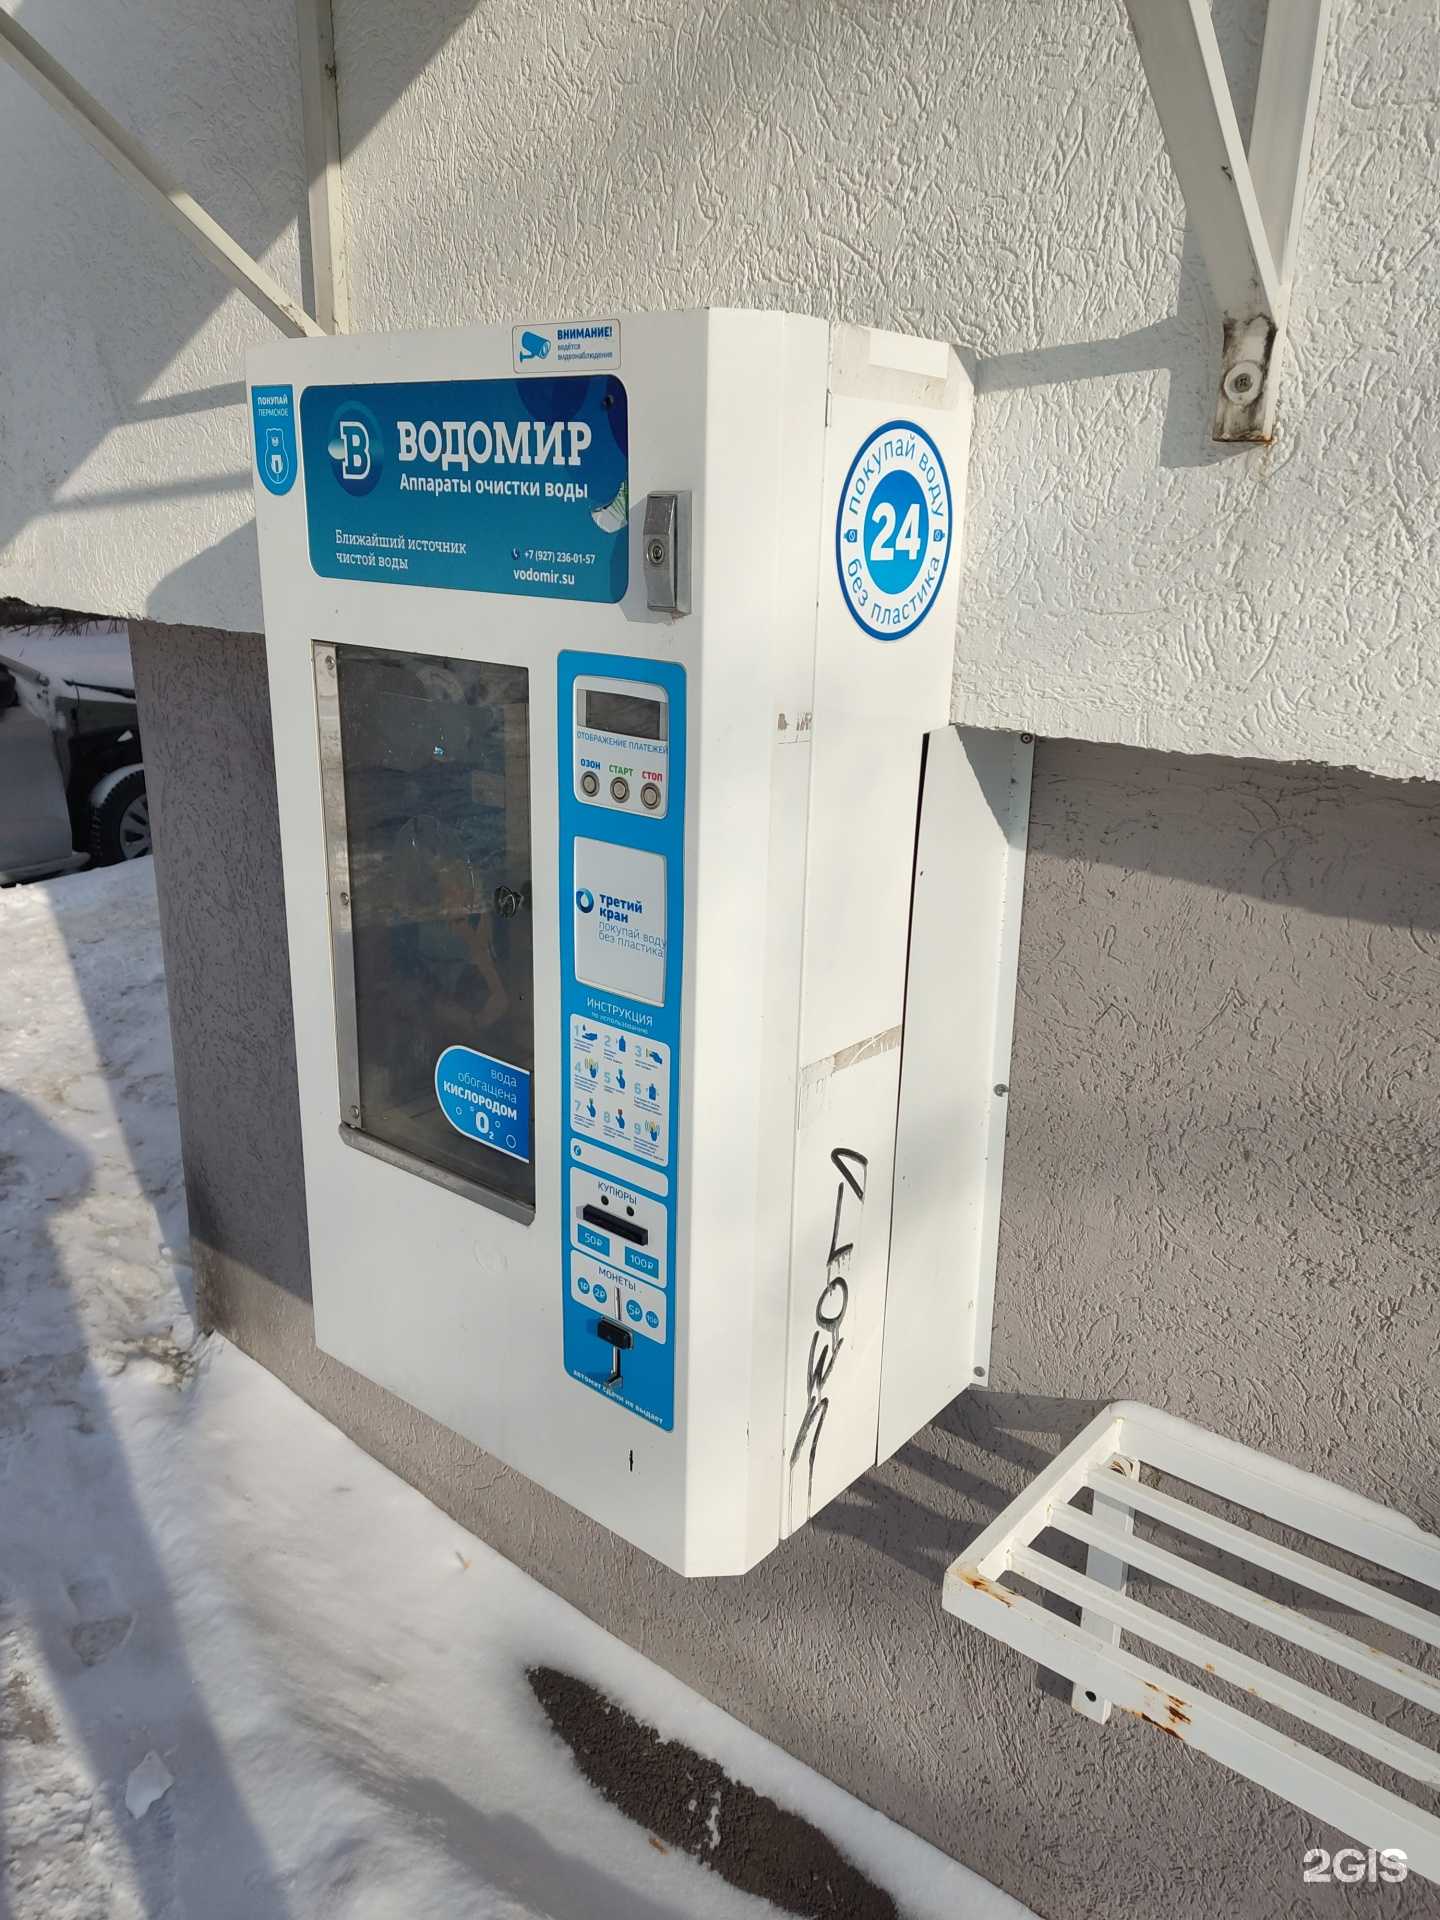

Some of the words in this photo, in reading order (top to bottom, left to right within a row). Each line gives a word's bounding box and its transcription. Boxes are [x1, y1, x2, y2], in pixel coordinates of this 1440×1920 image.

[557, 326, 613, 340] ВНИМАНИЕ!
[257, 394, 288, 406] ПОКУПАЙ
[396, 420, 592, 472] ВОДОМИР
[400, 473, 471, 496] Аппараты
[475, 479, 540, 497] очистки
[544, 482, 589, 502] воды
[849, 434, 916, 515] покупай
[918, 452, 944, 517] воду
[335, 529, 406, 549] Ближайший
[408, 538, 467, 554] источник
[870, 502, 921, 561] 24
[336, 552, 376, 566] чистой
[378, 556, 409, 570] воды
[525, 549, 534, 560] +7
[535, 550, 555, 563] (927)
[556, 551, 595, 564] 236-01-57
[513, 568, 575, 585] vodomir.su
[847, 558, 869, 607] без
[870, 557, 940, 625] пластика
[576, 731, 627, 748] ОТОБРАЖЕНИЕ
[580, 758, 601, 770] ОЗОН
[608, 764, 634, 777] СТАРТ
[641, 771, 663, 782] СТОП
[599, 893, 643, 914] третий
[599, 907, 629, 924] кран
[598, 930, 615, 944] без
[617, 936, 664, 958] пластика
[599, 921, 640, 940] покупай
[642, 934, 666, 950] воду
[586, 996, 653, 1026] ИНСТРУКЦИЯ
[458, 1072, 517, 1104] обогащена
[490, 1069, 517, 1087] вода
[443, 1080, 517, 1121] КИСЛОРОДОМ
[597, 1181, 637, 1205] КУПЮРЫ
[598, 1266, 636, 1292] МОНЕТЫ
